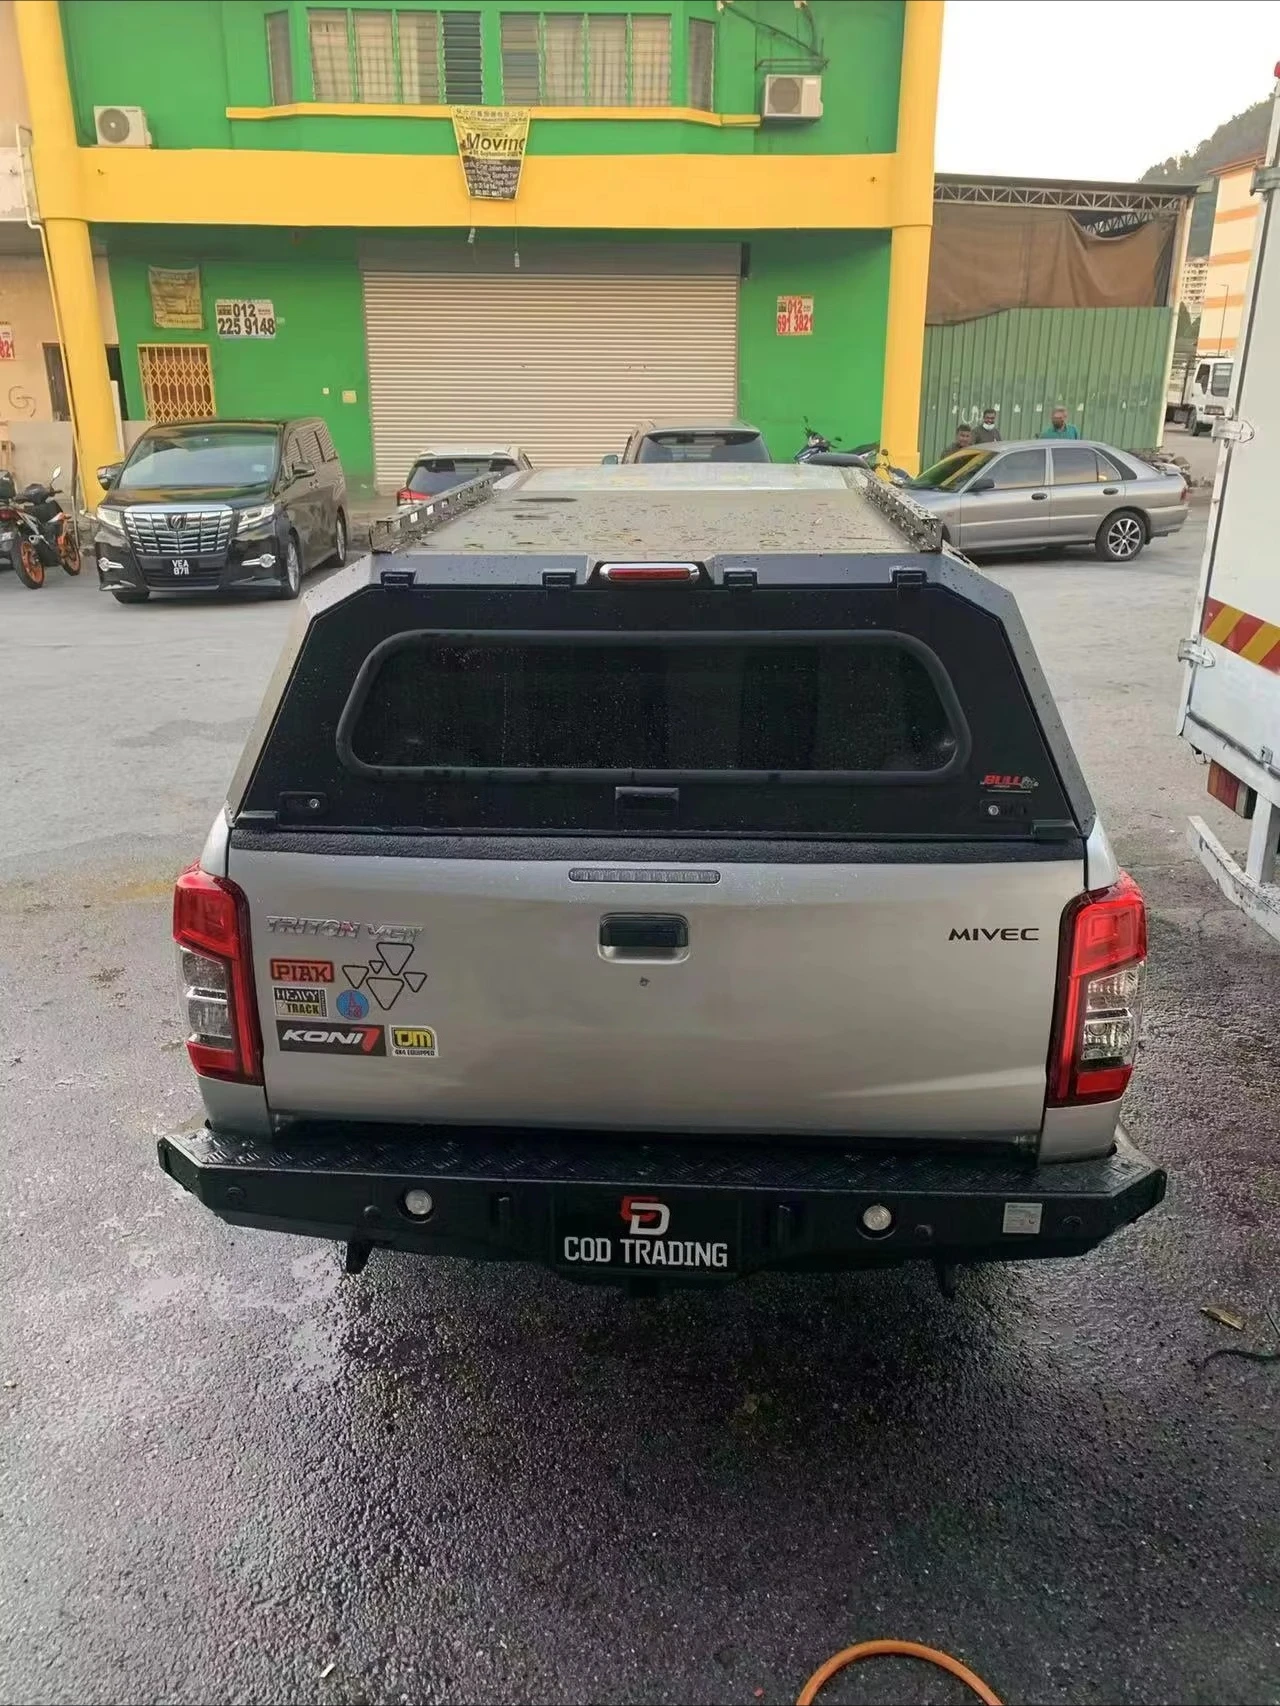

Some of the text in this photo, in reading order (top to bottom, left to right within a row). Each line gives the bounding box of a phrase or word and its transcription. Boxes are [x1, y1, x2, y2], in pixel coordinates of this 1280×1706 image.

[233, 303, 256, 318] 012
[788, 299, 803, 313] 012
[218, 318, 275, 335] 225 9148
[794, 313, 813, 332] 3821
[172, 559, 189, 568] VEA
[266, 915, 360, 938] TRITON
[948, 928, 1040, 941] MIVEC
[286, 1003, 320, 1014] TRACK
[564, 1236, 728, 1268] COD TRADING
